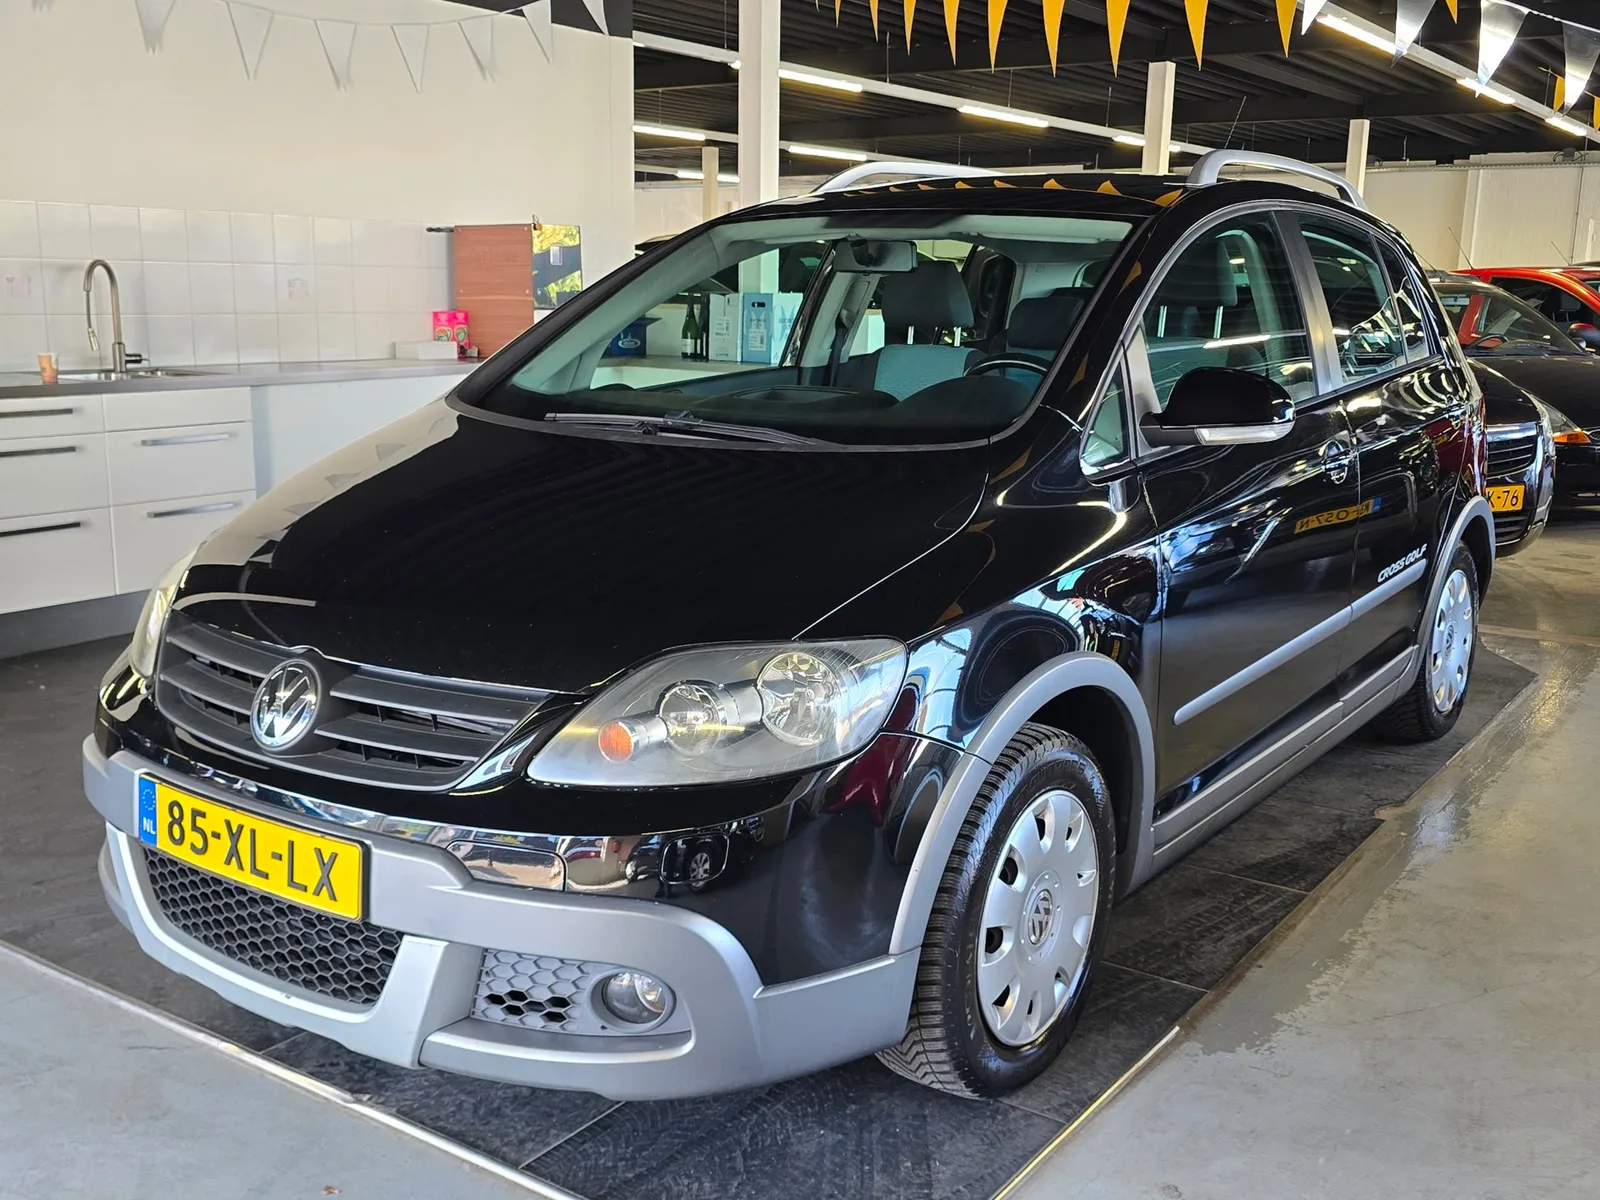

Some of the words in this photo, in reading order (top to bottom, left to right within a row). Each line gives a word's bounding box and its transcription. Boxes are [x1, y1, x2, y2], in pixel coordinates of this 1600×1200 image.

[1377, 557, 1406, 582] CROSS
[1405, 543, 1427, 566] GOLF
[142, 816, 157, 835] NL
[167, 799, 338, 902] 85-XL-LX
